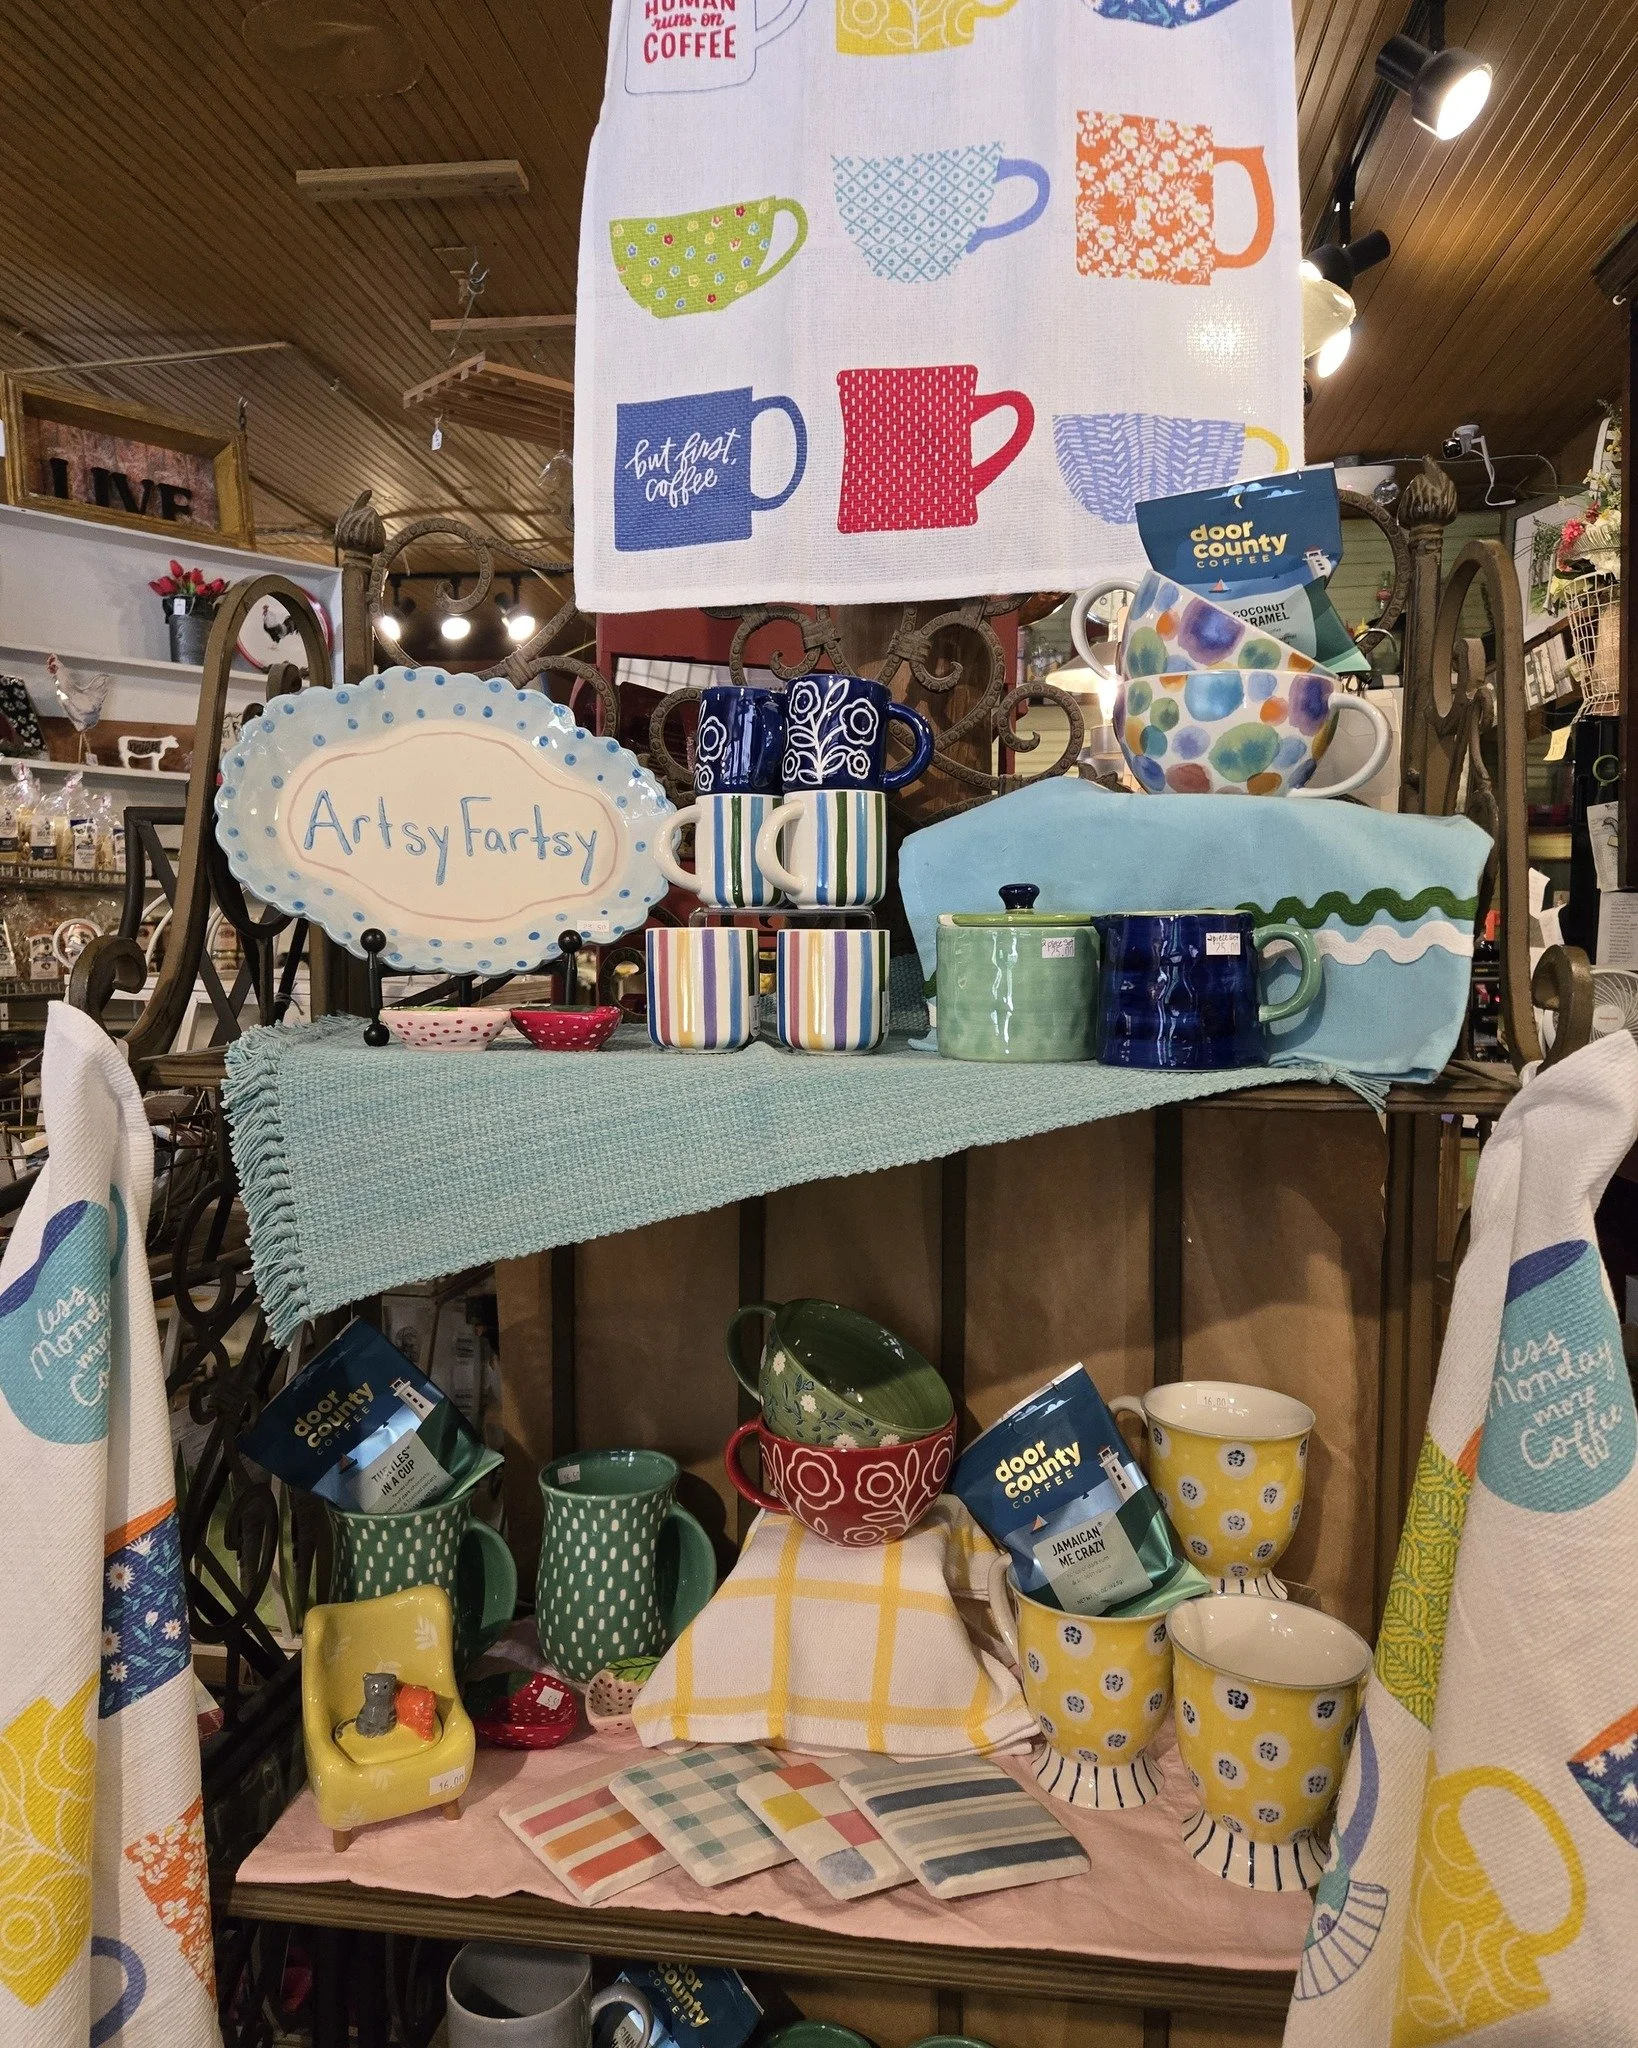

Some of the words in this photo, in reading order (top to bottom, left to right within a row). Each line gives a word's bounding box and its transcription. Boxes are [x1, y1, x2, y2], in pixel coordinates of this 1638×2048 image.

[651, 12, 697, 31] runs
[701, 13, 725, 26] on
[643, 25, 736, 63] COFFEE
[625, 437, 676, 480] but
[674, 428, 741, 473] first,
[646, 466, 718, 508] coffee
[1190, 521, 1253, 542] door
[1193, 534, 1288, 559] county
[1196, 554, 1270, 568] COFFEE
[1244, 611, 1290, 627] RAMEL
[303, 789, 449, 886] Artsy
[460, 796, 597, 886] Fartsy
[294, 1389, 340, 1437] door
[307, 1382, 374, 1448] county
[1533, 1384, 1597, 1427] more
[317, 1405, 371, 1456] COFFEE
[1520, 1404, 1623, 1470] Coffee
[381, 1482, 392, 1496] IN
[391, 1476, 400, 1486] A
[398, 1459, 415, 1479] CUP
[995, 1440, 1047, 1482] door
[1005, 1441, 1081, 1498] county
[1012, 1469, 1074, 1509] COFFEE
[1058, 1553, 1075, 1568] ME
[1075, 1539, 1106, 1561] CRAZY
[648, 1968, 687, 2024] COFFEE
[657, 1961, 710, 2028] county
[678, 1962, 704, 1993] oor
